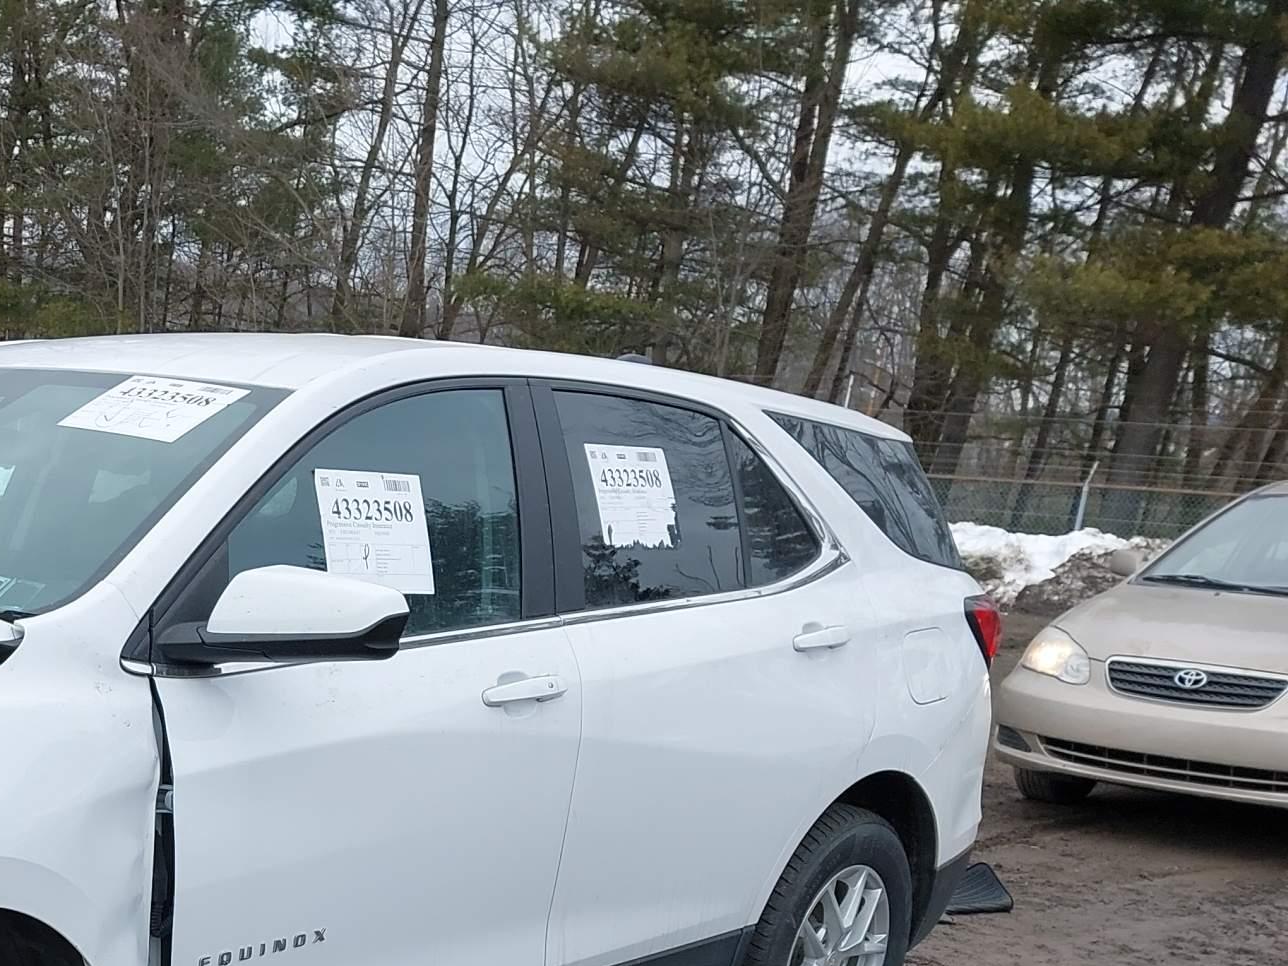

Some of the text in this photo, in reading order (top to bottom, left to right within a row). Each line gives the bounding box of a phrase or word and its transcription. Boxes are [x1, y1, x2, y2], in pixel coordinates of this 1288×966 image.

[120, 386, 217, 407] 43323508
[601, 468, 662, 488] 43323508
[332, 498, 414, 522] 43323508
